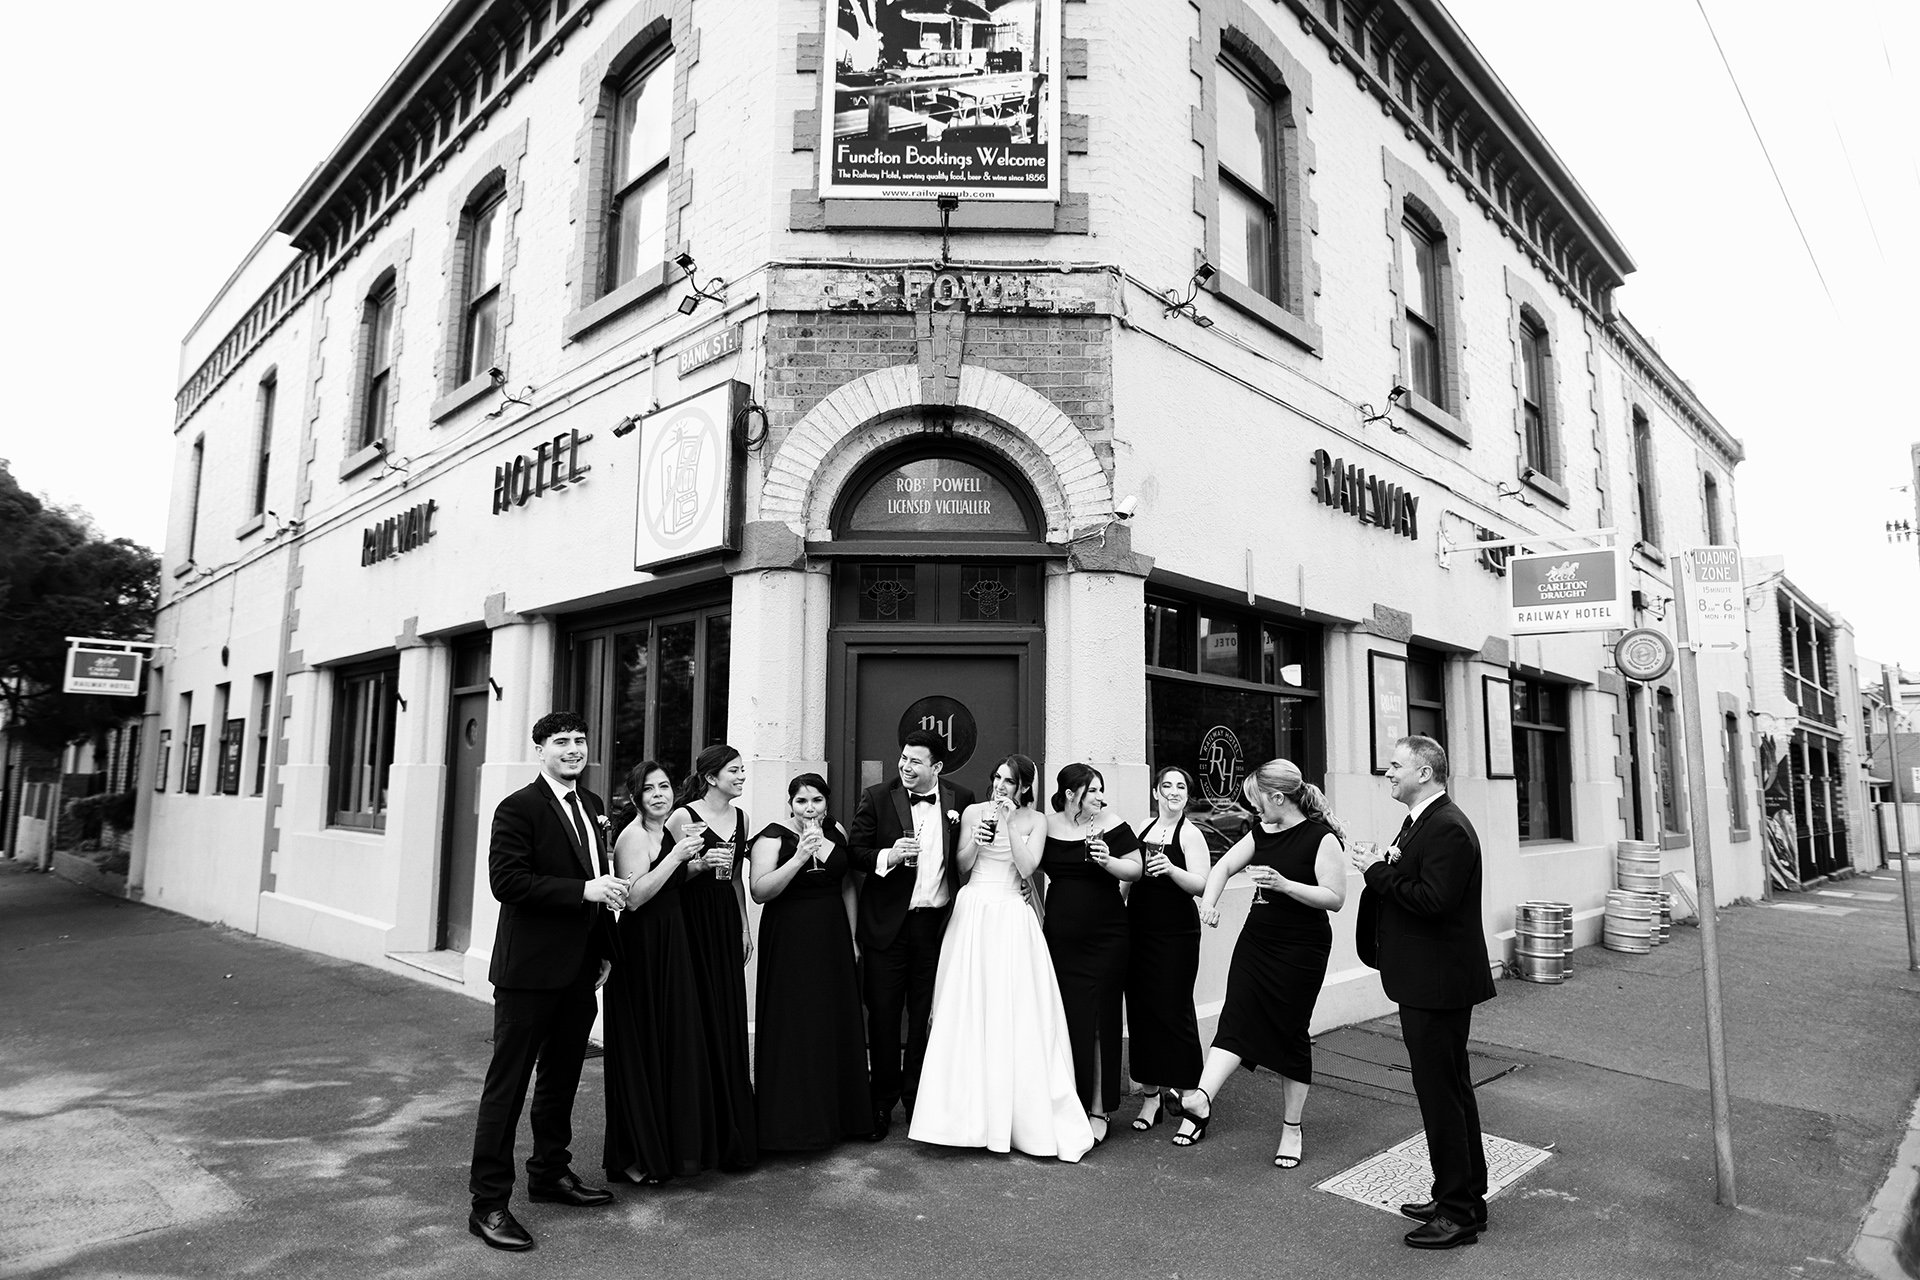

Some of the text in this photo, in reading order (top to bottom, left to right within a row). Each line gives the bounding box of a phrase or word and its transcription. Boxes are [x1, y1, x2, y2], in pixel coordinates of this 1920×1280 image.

[837, 144, 1046, 170] Function Bookings Welcome
[838, 169, 851, 179] The
[852, 169, 880, 181] Railway
[881, 170, 902, 181] Hotel,
[902, 172, 926, 182] serving
[926, 171, 949, 183] quality
[967, 171, 982, 182] beer
[983, 171, 991, 182] &
[992, 172, 1008, 182] wine
[1008, 173, 1024, 183] since
[1025, 172, 1046, 183] 1856
[681, 340, 710, 372] BANK
[932, 477, 982, 493] POWELL
[361, 427, 590, 568] RAILWAY HOTEL
[1313, 447, 1421, 541] RAILWAY
[888, 498, 991, 515] LICENSED VICTUALLER
[1694, 550, 1736, 565] LOADING
[1700, 566, 1732, 581] ZONE
[1537, 579, 1589, 593] CARLTON
[1540, 588, 1587, 600] DRAUGHT
[1518, 607, 1612, 623] RAILWAY HOTEL
[73, 680, 132, 690] RAILWAY HOTEL
[1203, 729, 1240, 755] RAILWAY HOTEL
